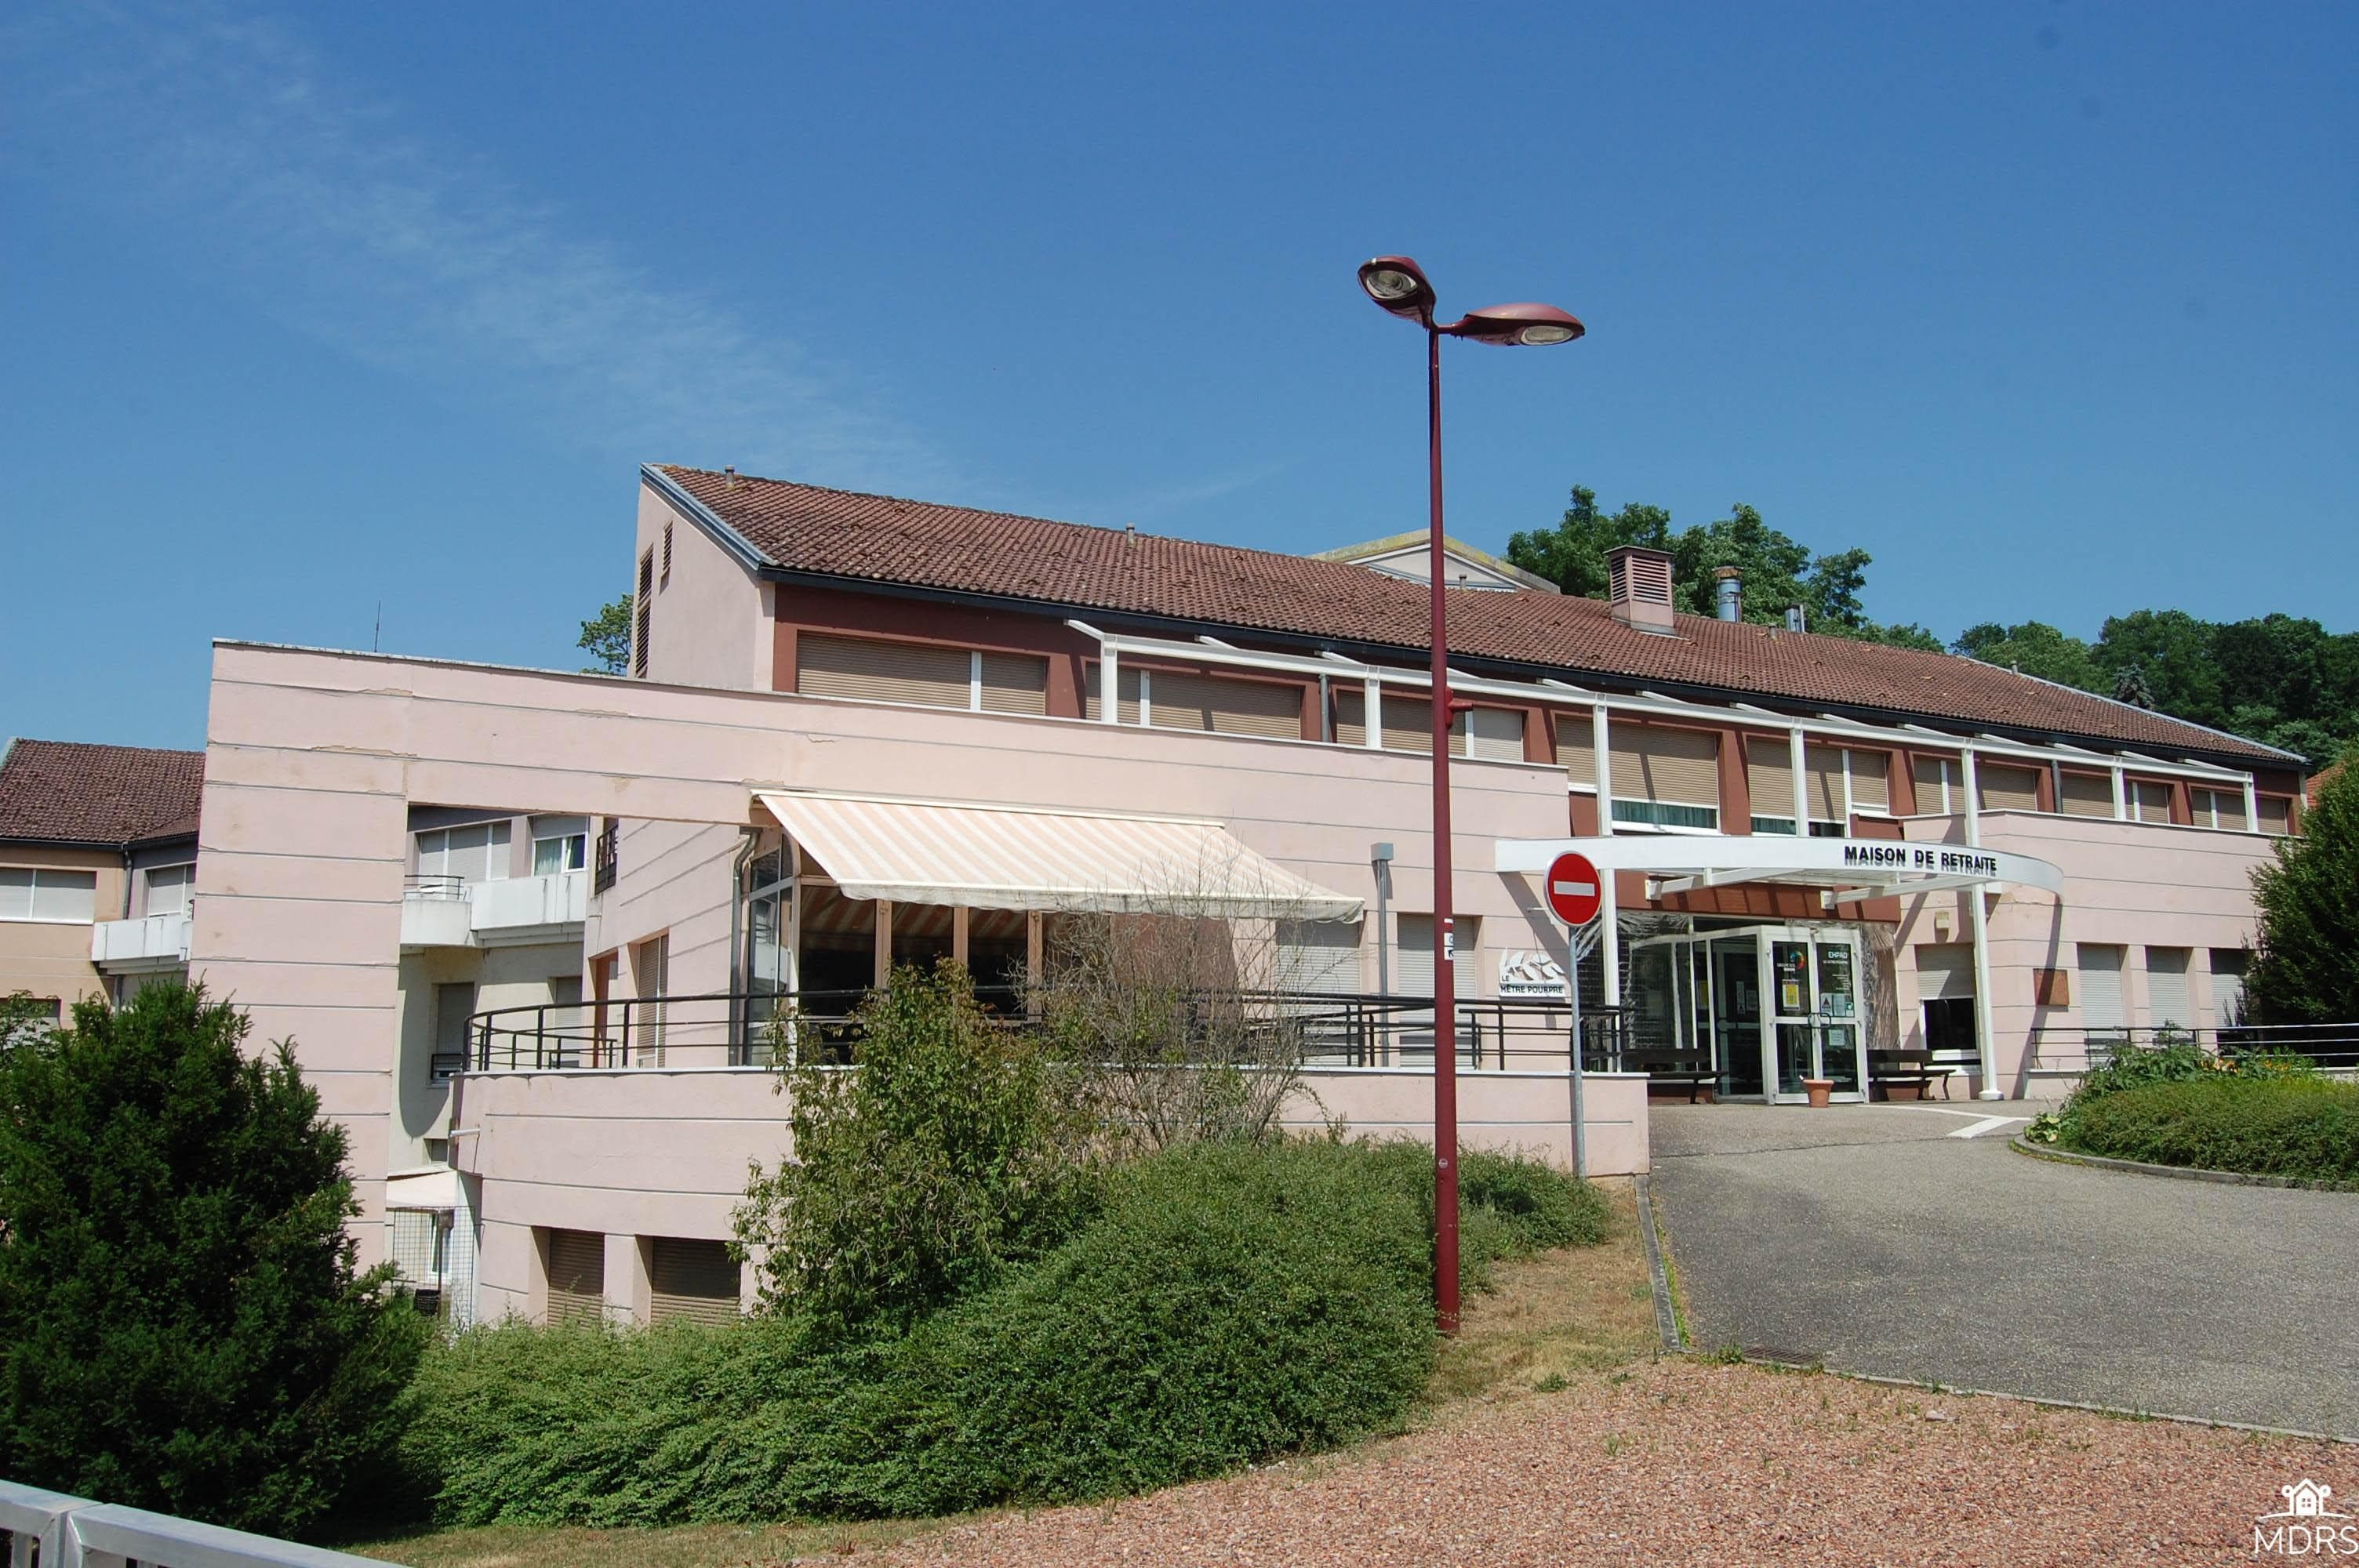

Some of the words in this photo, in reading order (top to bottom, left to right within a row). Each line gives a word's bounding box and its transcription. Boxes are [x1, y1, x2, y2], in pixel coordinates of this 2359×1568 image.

[1845, 846, 1906, 862] MAISON
[1914, 850, 1935, 864] DE
[1941, 852, 1997, 872] RETRAITE
[1528, 985, 1563, 994] POURPRE
